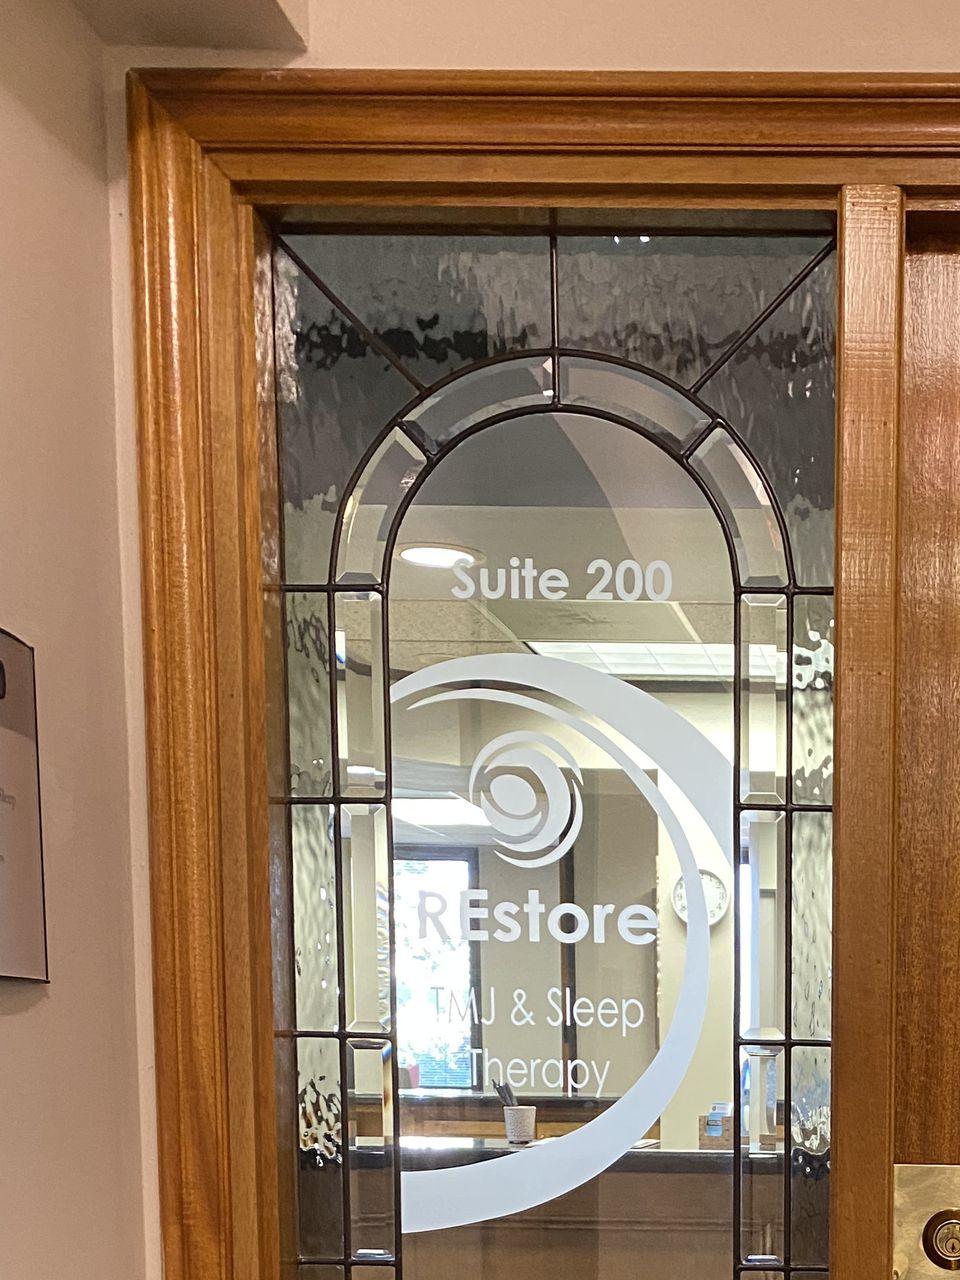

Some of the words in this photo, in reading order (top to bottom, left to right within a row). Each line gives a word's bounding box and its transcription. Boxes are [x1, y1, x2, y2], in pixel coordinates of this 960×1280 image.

[451, 557, 570, 600] Suite
[585, 559, 673, 602] 200
[418, 889, 657, 945] REstore
[431, 986, 495, 1026] TMJ
[510, 989, 536, 1026] &
[546, 987, 645, 1037] Sleep
[470, 1048, 610, 1098] Therapy
